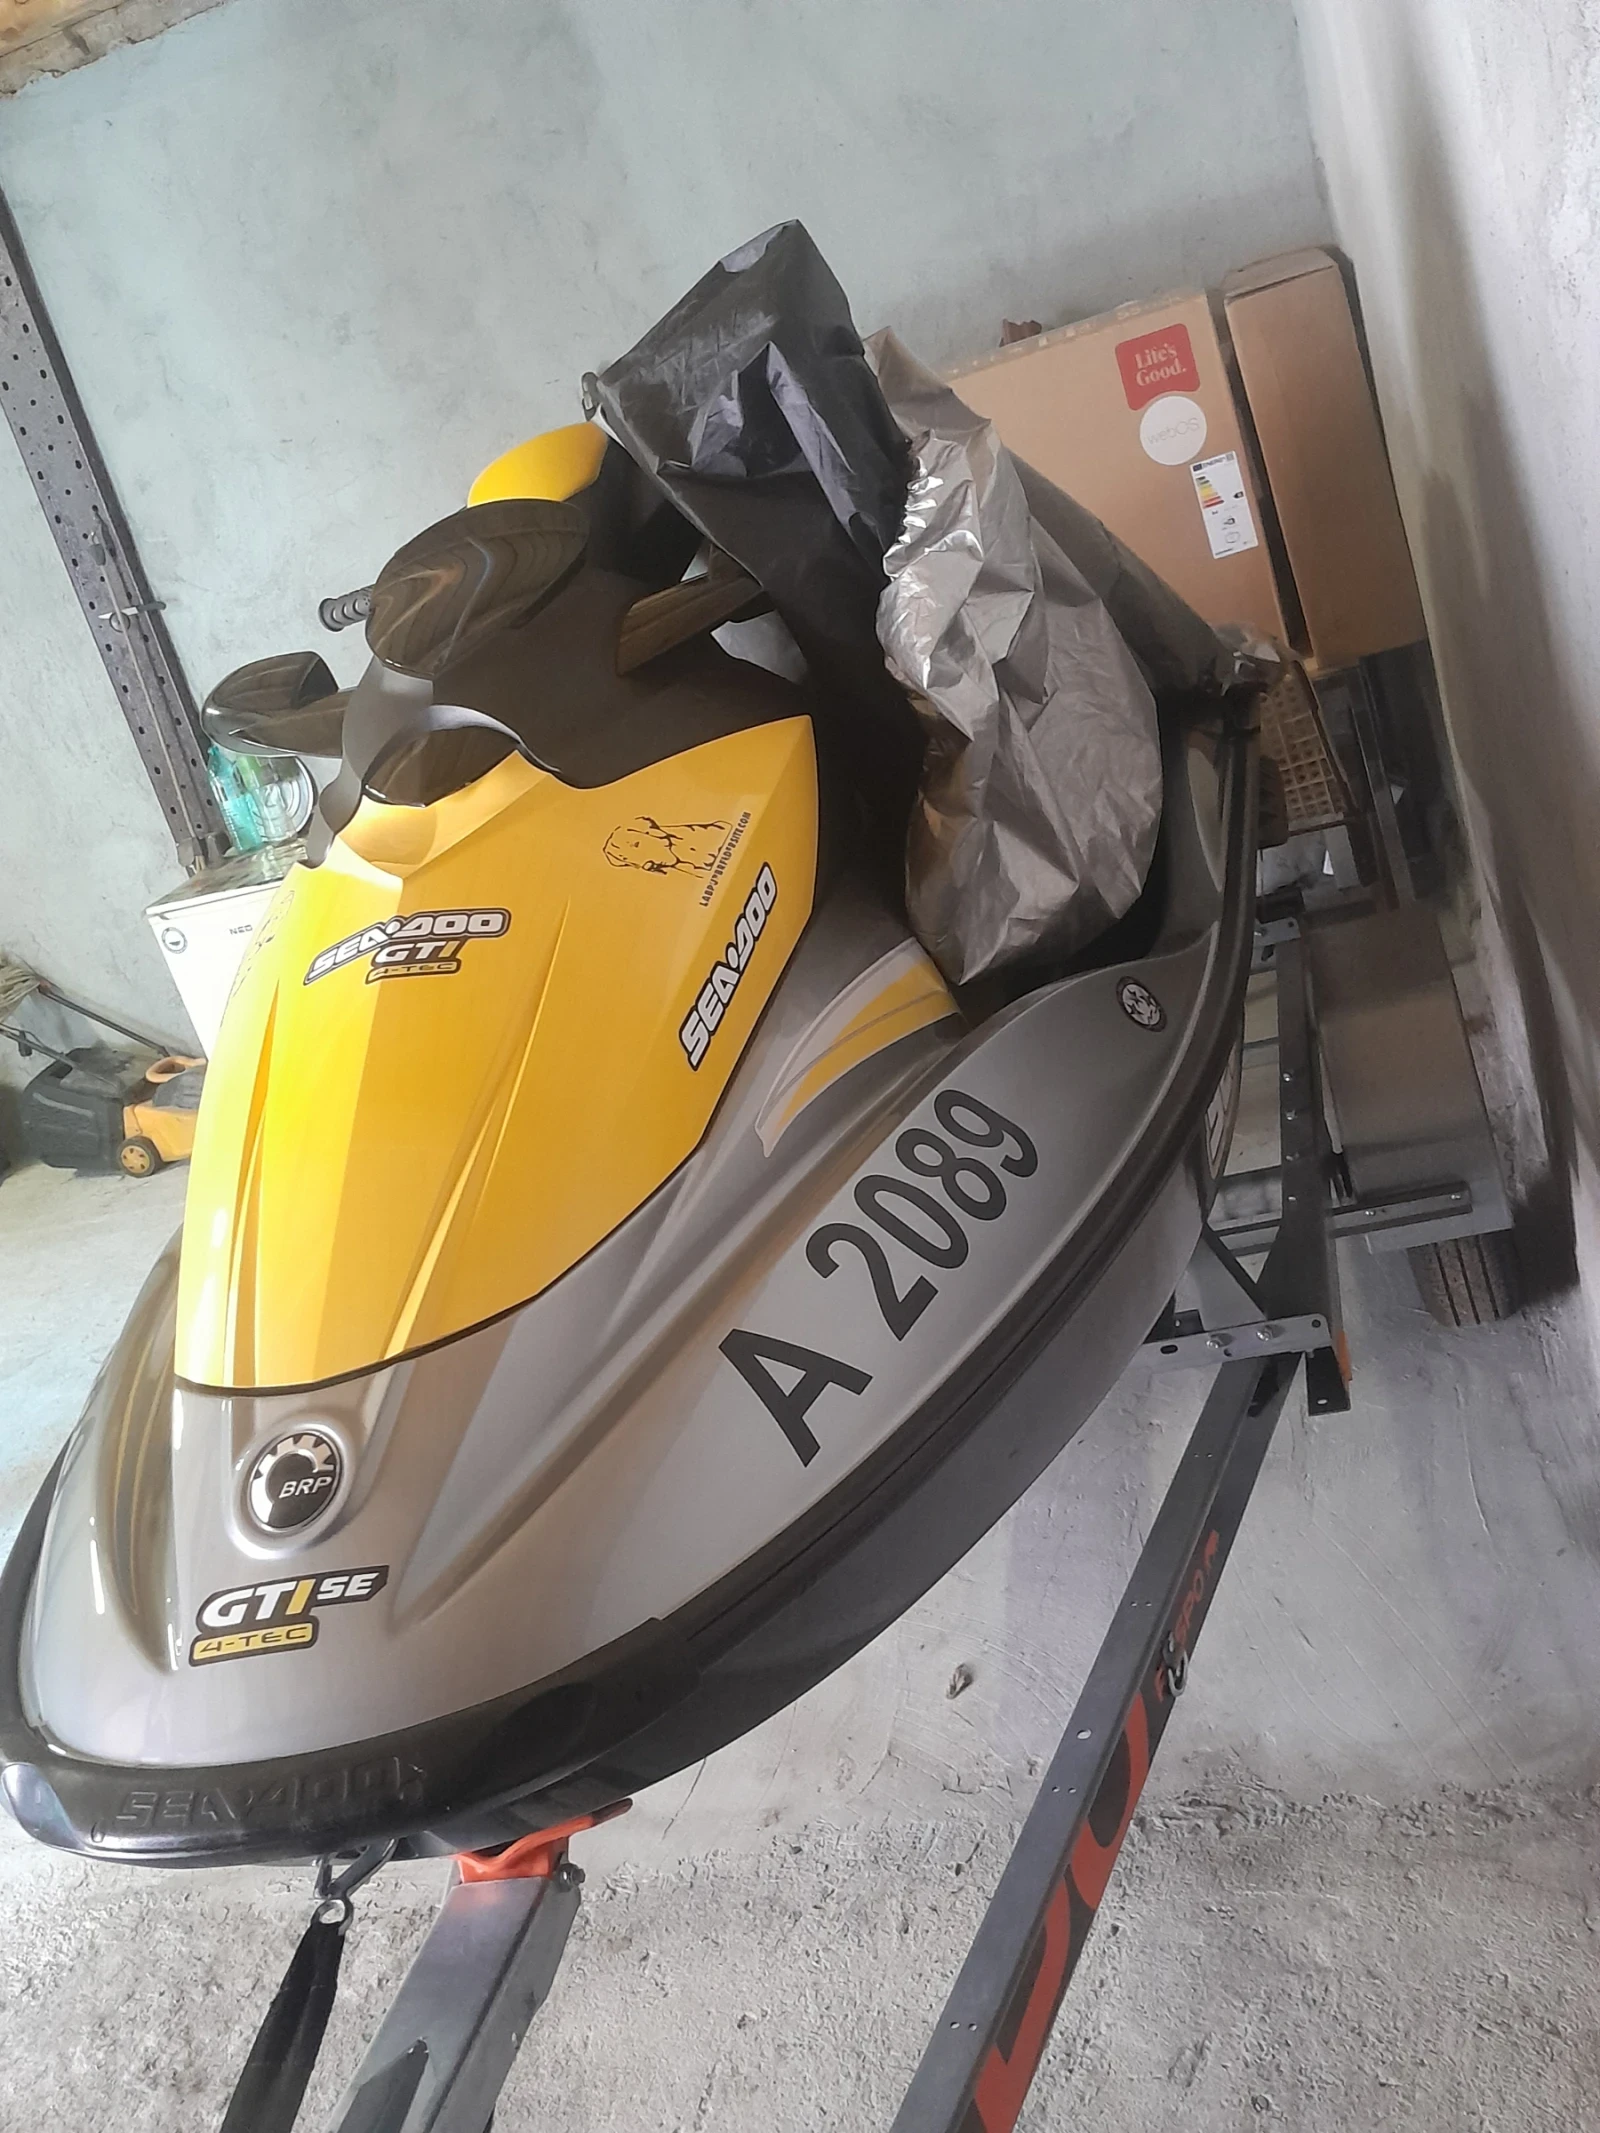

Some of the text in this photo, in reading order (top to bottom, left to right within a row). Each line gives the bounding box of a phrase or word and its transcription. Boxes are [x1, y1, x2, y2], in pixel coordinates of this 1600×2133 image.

[1134, 342, 1178, 369] Life's
[1136, 358, 1188, 387] Good.
[1145, 417, 1200, 445] webOS
[375, 941, 461, 964] GTI
[718, 1089, 1039, 1468] A 2089
[279, 1476, 333, 1498] BRP
[202, 1573, 380, 1627] GTI SE
[199, 1627, 308, 1653] 4-TEC
